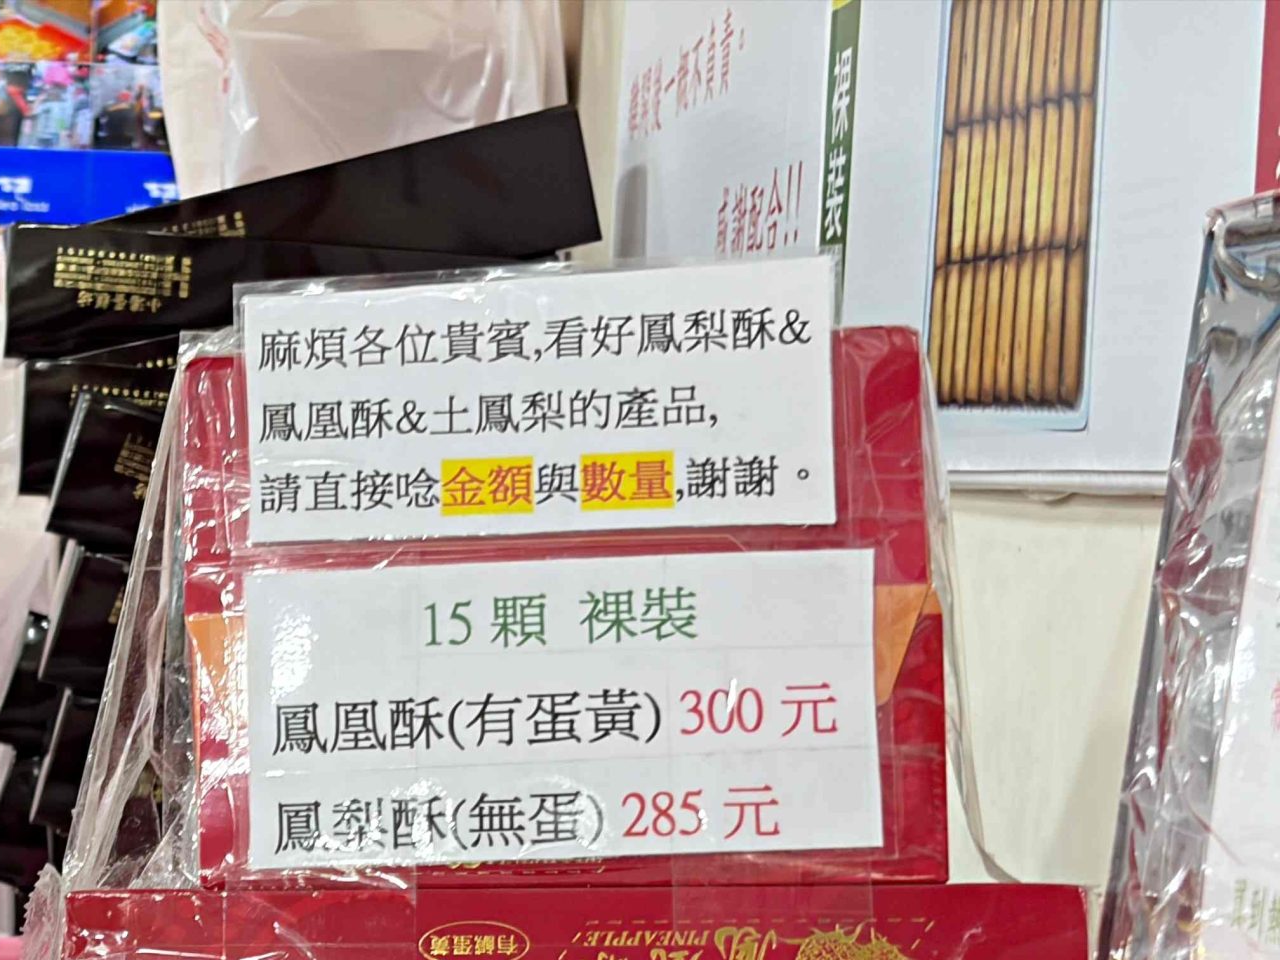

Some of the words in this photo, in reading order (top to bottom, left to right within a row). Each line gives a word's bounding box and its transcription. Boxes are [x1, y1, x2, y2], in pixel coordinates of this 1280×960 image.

[824, 46, 853, 241] 裸裝
[258, 307, 811, 372] 麻煩各位貴賓,看好鳳梨酥&
[259, 385, 718, 443] 鳳凰酥&土鳳梨的產品,
[259, 454, 810, 515] 請直接唸金額與數量,謝謝。
[423, 600, 472, 648] 15
[490, 593, 548, 648] 顆
[579, 587, 698, 644] 裸裝
[271, 690, 661, 757] 鳳凰酥(有蛋黃)
[680, 686, 763, 737] 300
[780, 682, 838, 738] 元
[274, 790, 605, 855] 鳳梨酥(無蛋)
[622, 791, 702, 839] 285
[723, 784, 780, 839] 元
[429, 934, 518, 957] 有鹹蛋黃
[584, 929, 709, 947] PINEAPPLE
